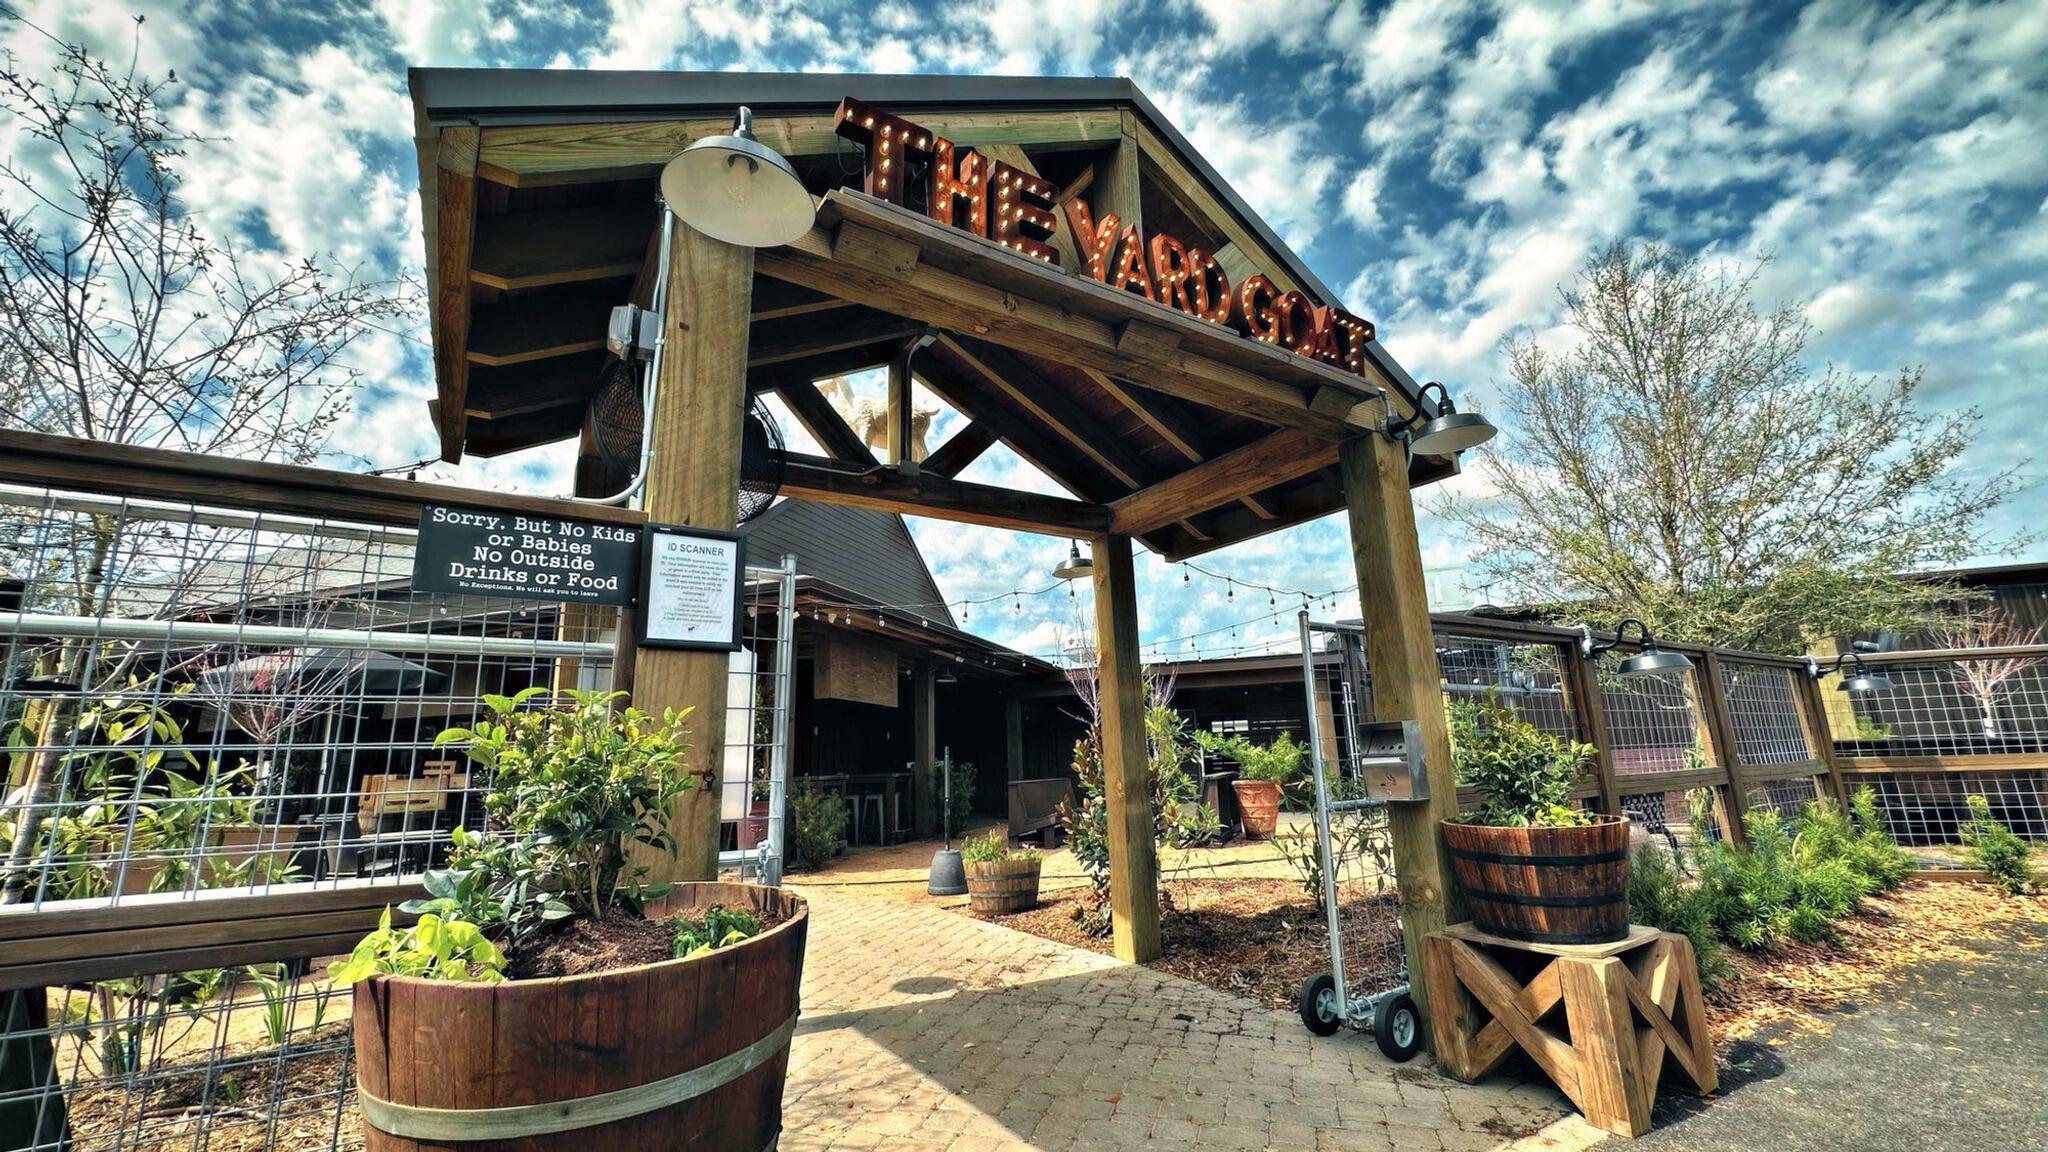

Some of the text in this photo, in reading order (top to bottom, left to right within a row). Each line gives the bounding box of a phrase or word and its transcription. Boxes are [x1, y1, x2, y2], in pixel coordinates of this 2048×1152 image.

[834, 96, 1376, 377] THE YARD GOAT
[513, 517, 552, 534] But
[558, 523, 585, 537] No
[592, 526, 636, 543] Kids
[488, 535, 592, 555] or Babies
[667, 543, 724, 556] ID SCANNER
[473, 547, 595, 571] No Outside
[449, 563, 618, 590] Drinks or Food
[580, 590, 599, 598] leave
